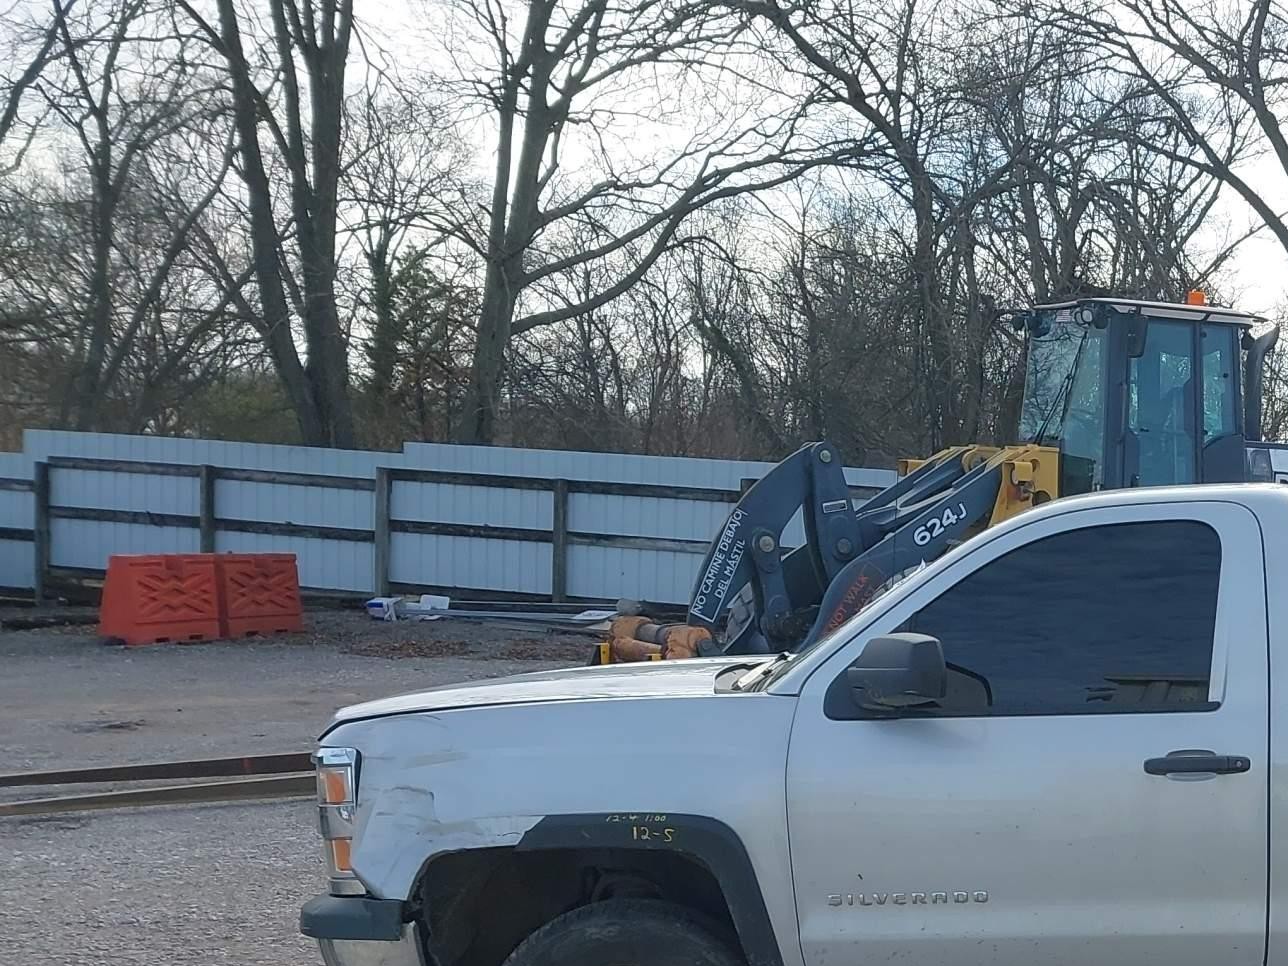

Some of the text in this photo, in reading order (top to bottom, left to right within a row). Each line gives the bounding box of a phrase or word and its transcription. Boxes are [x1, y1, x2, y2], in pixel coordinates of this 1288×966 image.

[913, 503, 967, 546] 624J
[693, 510, 742, 614] NO CAMINE DEBAJO
[714, 539, 746, 599] DEL MÁSTIL
[633, 826, 675, 842] 12-5
[827, 890, 989, 907] SILVERADO
